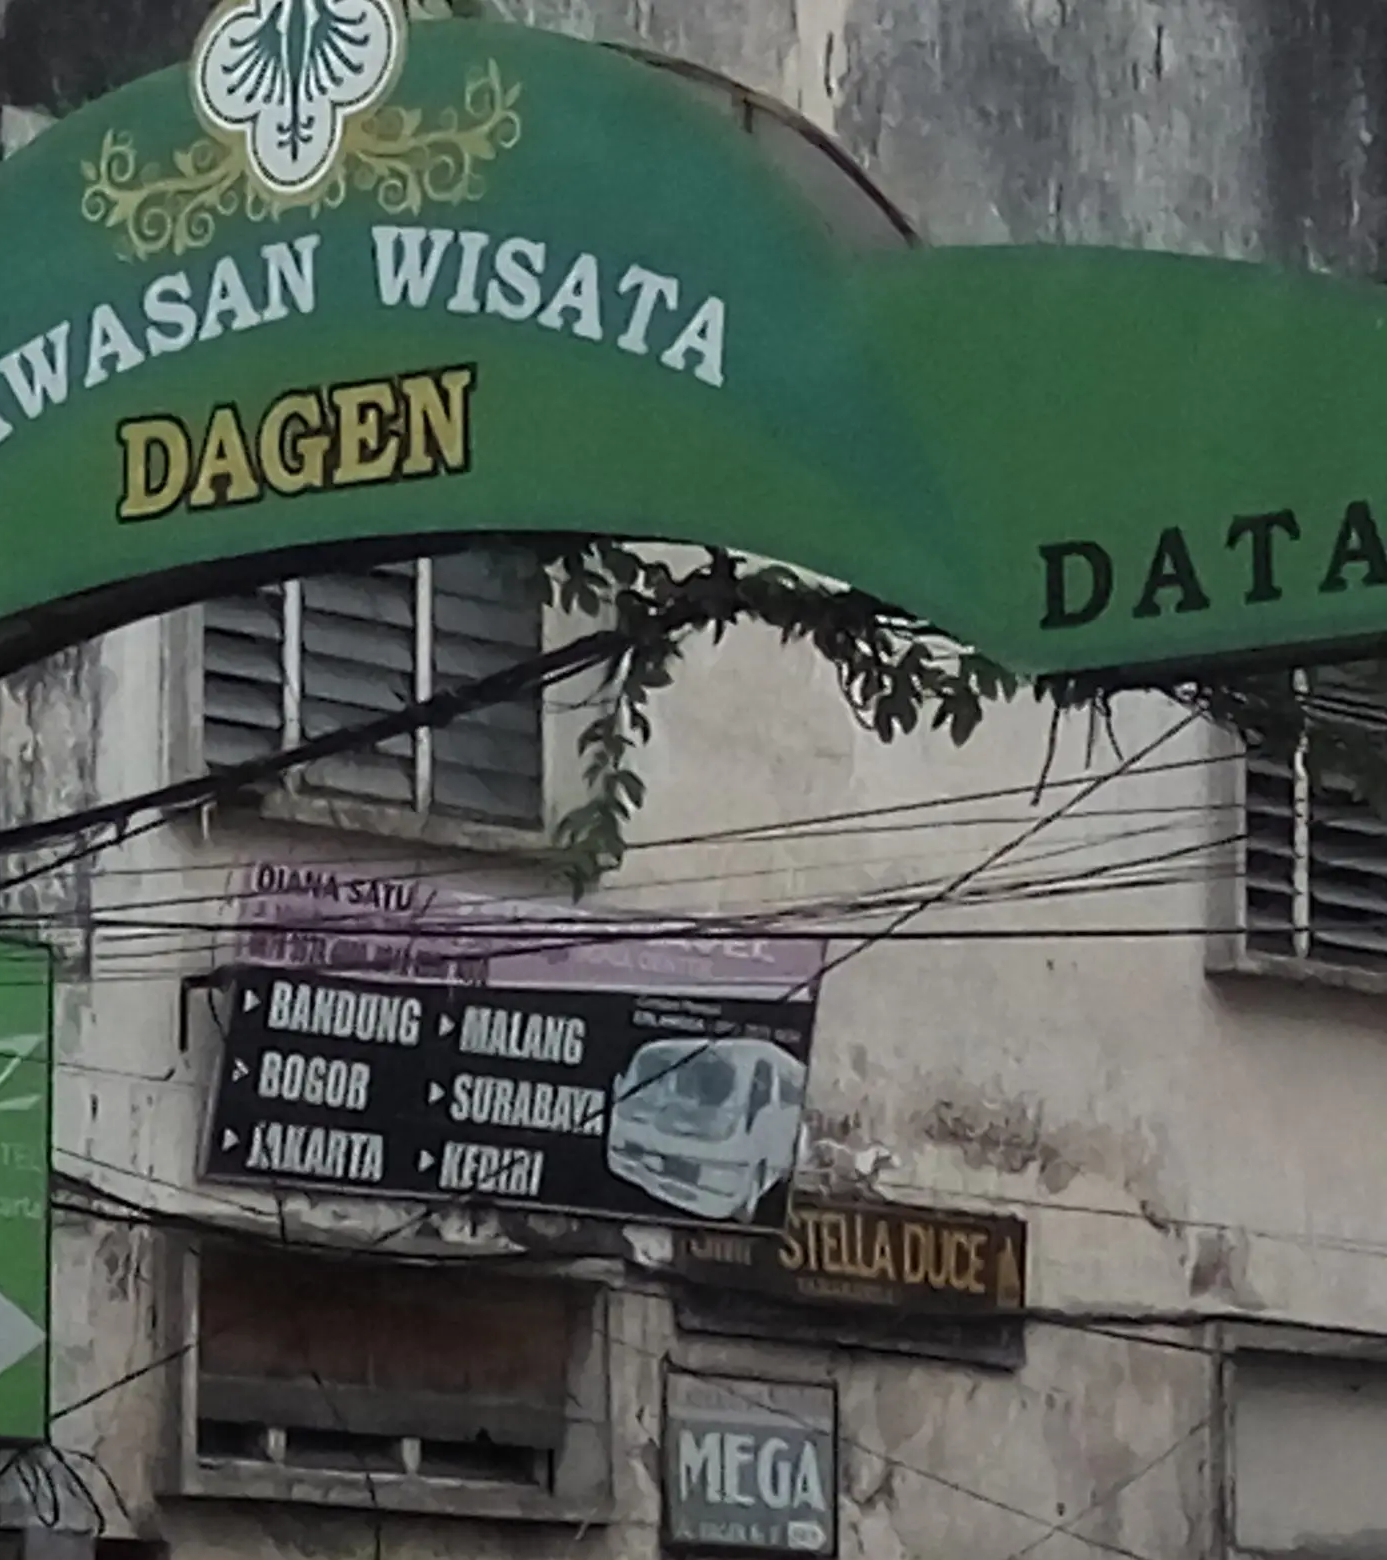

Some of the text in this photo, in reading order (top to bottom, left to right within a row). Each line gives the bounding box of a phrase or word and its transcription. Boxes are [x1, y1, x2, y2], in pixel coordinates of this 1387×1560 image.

[371, 224, 729, 388] WISATA
[115, 362, 478, 522] DAGEN
[347, 878, 416, 913] SATU
[268, 989, 422, 1045] BANDUNG
[460, 1005, 585, 1065] MALANG
[258, 1056, 369, 1109] BOGOR
[450, 1075, 605, 1136] SURABAYA
[246, 1121, 384, 1181] JAKARTA
[438, 1142, 544, 1197] KEDIRI
[778, 1207, 897, 1281] STELLA
[903, 1220, 988, 1295] DUCE
[678, 1428, 826, 1513] MEGA
